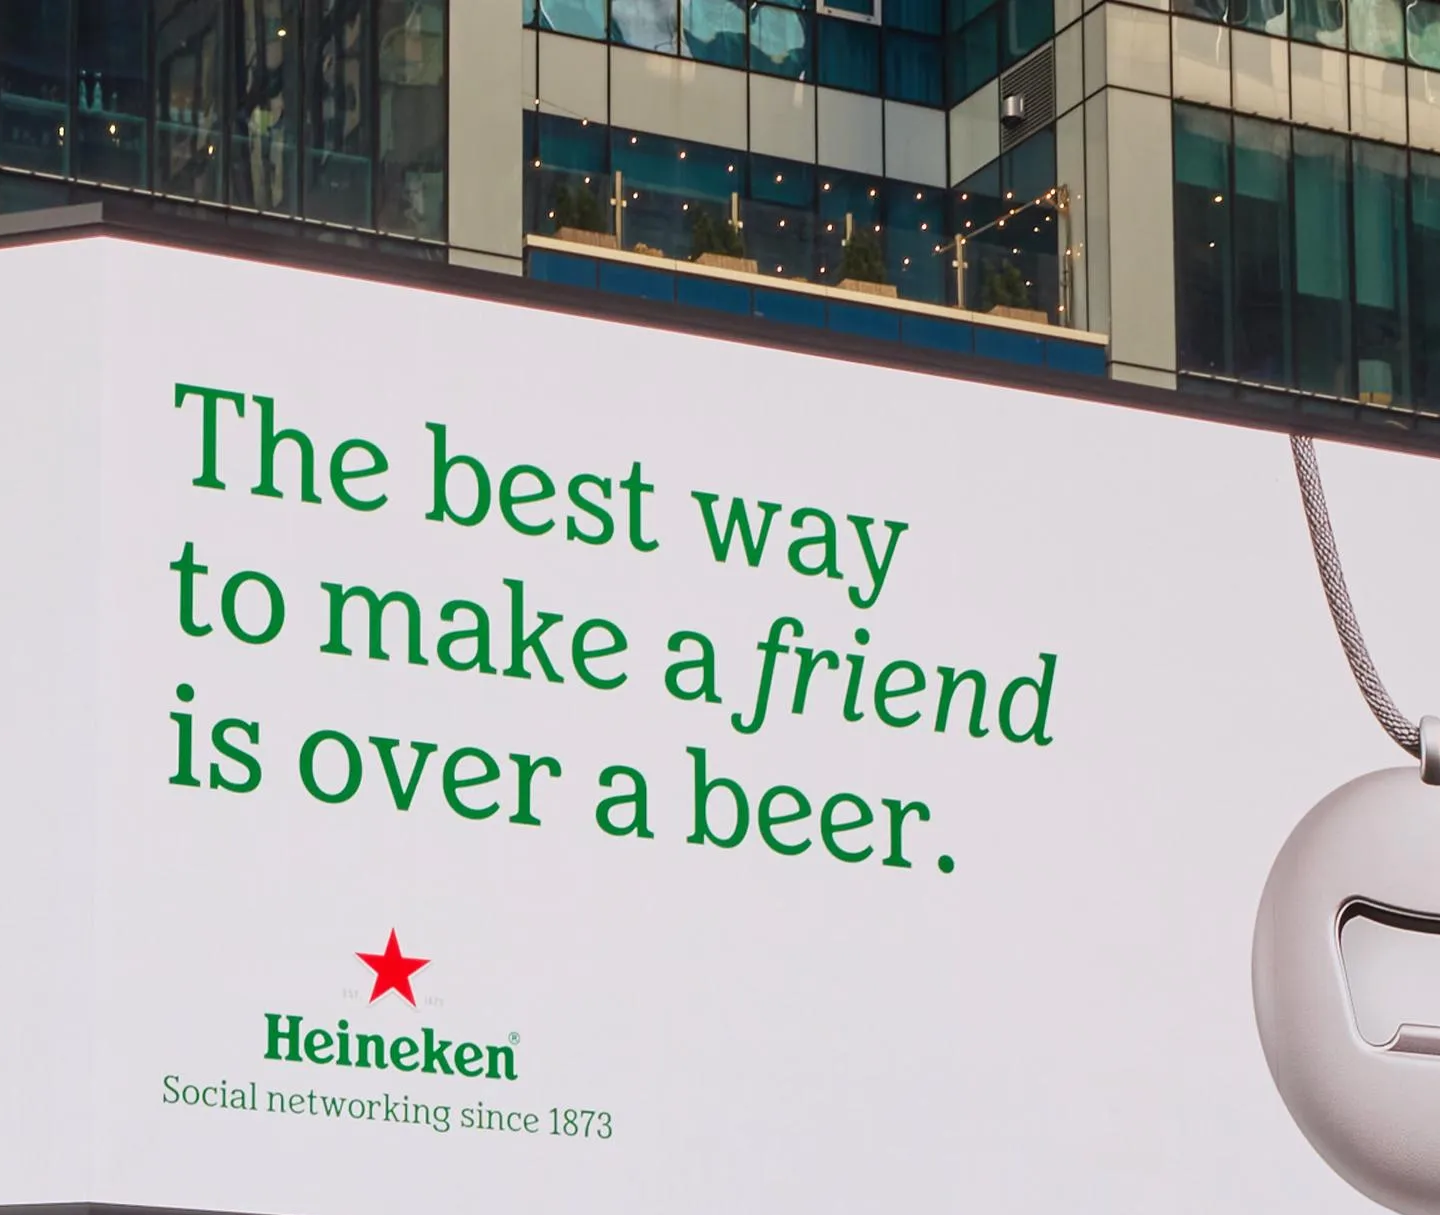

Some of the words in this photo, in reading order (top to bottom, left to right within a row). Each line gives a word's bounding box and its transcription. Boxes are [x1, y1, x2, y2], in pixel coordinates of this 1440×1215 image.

[174, 383, 389, 511] The
[425, 421, 659, 552] best
[691, 488, 909, 610] way
[169, 541, 286, 645] to
[320, 578, 628, 690] make
[664, 628, 723, 704] a
[731, 616, 1057, 746] friend
[168, 684, 263, 793] is
[298, 729, 562, 826] over
[595, 763, 655, 840] a
[686, 746, 956, 874] beer.
[162, 1075, 258, 1112] Social
[267, 1087, 451, 1132] networking
[460, 1102, 539, 1133] since
[549, 1108, 613, 1139] 1873
